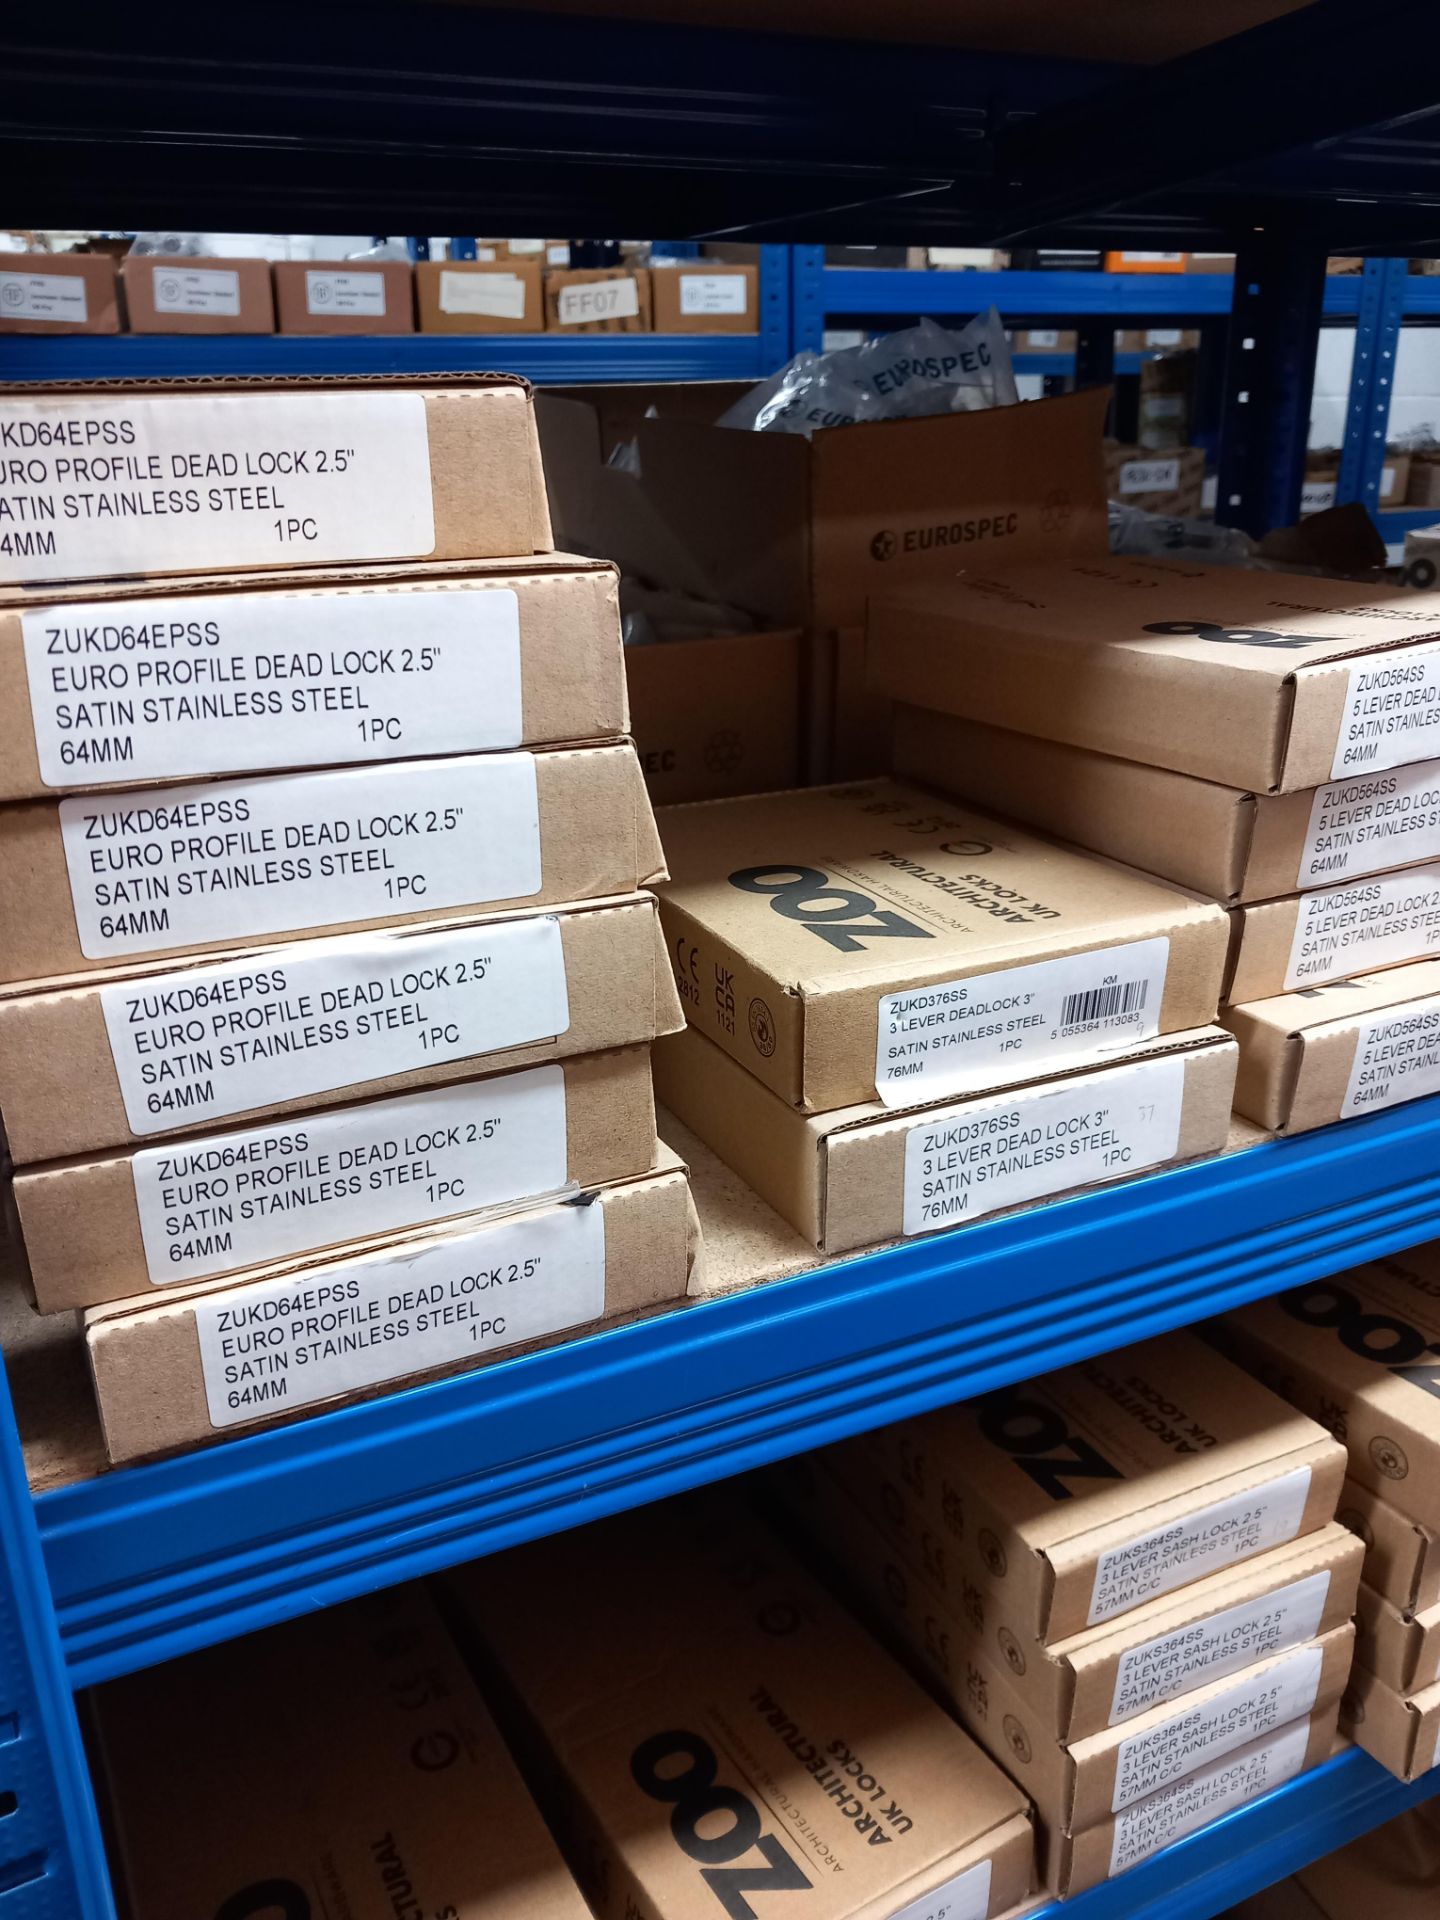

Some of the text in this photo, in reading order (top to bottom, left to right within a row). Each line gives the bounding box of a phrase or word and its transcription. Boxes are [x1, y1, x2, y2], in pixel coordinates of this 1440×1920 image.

[565, 289, 620, 315] FF07
[872, 342, 992, 397] EUROSPEC
[56, 449, 354, 482] PROFILE DEAD LOCK 2.5"
[63, 486, 284, 518] STAINLESS STEEL
[275, 518, 317, 541] 1PC
[903, 513, 1019, 554] EUROSPEC
[46, 622, 219, 654] ZUKD64EPSS
[52, 648, 440, 692] EURO PROFILE DEAD LOCK 2.5"
[1357, 665, 1424, 692] ZUKD564SS
[56, 687, 368, 729] SATIN STAINLESS STEEL
[1353, 687, 1439, 716] 5 LEVER DEAD
[61, 718, 401, 764] 64MM 1PC
[1349, 719, 1384, 740] SATIN
[1344, 743, 1378, 764] 64MM
[1319, 797, 1410, 830] 5 LEVER DEAD
[1323, 778, 1396, 808] ZUKD564SS
[84, 799, 249, 839] ZUKD64EPSS
[1315, 814, 1425, 852] SATIN STAINLESS
[90, 808, 462, 873] EURO PROFILE DEAD LOCK 2.5"
[95, 849, 394, 906] SATIN STAINLESS STEEL
[1311, 852, 1348, 874] 64MM
[100, 875, 426, 938] 64MM 1PC
[870, 849, 1036, 924] ARCHITECTURAL
[957, 873, 1062, 920] UK LOCKS
[1309, 885, 1381, 915] ZUKD564SS
[1305, 894, 1430, 936] 5 LEVER DEAD LOCK
[1301, 918, 1408, 956] SATIN STAINLESS
[1297, 956, 1332, 977] 64MM
[126, 970, 286, 1023] ZUKD64EPSS
[135, 957, 491, 1054] EURO PROFILE DEAD LOCK 2.5"
[890, 989, 967, 1014] ZUKD376SS
[890, 994, 1034, 1033] 3 LEVER DEADLOCK 3"
[141, 1003, 428, 1084] SATIN STAINLESS STEEL
[888, 1014, 1045, 1058] SATIN STAINLESS STEEL
[1000, 1039, 1022, 1052] 1PC
[1050, 1029, 1058, 1040] 5
[1367, 1013, 1439, 1044] ZUKD564SS
[148, 1024, 459, 1113] 64MM 1PC
[888, 1062, 923, 1078] 76MM
[1364, 1039, 1415, 1065] 5 LEVER
[1353, 1083, 1389, 1105] 64MM
[1359, 1064, 1396, 1085] SATIN
[924, 1112, 1020, 1152] ZUKD376SS
[924, 1110, 1108, 1175] 3 LEVER DEAD LOCK 3"
[157, 1133, 308, 1181] ZUKD64EPSS
[163, 1118, 500, 1208] EURO PROFILE DEAD LOCK 2.5"
[923, 1130, 1119, 1198] SATIN STAINLESS STEEL
[166, 1160, 436, 1235] SATIN STAINLESS STEEL
[922, 1147, 1131, 1221] 76MM 1PC
[170, 1179, 464, 1262] 64MM 1PC
[217, 1281, 359, 1332] ZUKD64EPSS
[222, 1258, 540, 1358] EURO PROFILE DEAD LOCK 2.5"
[225, 1301, 479, 1383] SATIN STAINLESS STEEL
[228, 1318, 505, 1408] 64MM 1PC
[748, 1683, 893, 1848] ARCHITECTURAL
[825, 1738, 914, 1836] UK LOCKS
